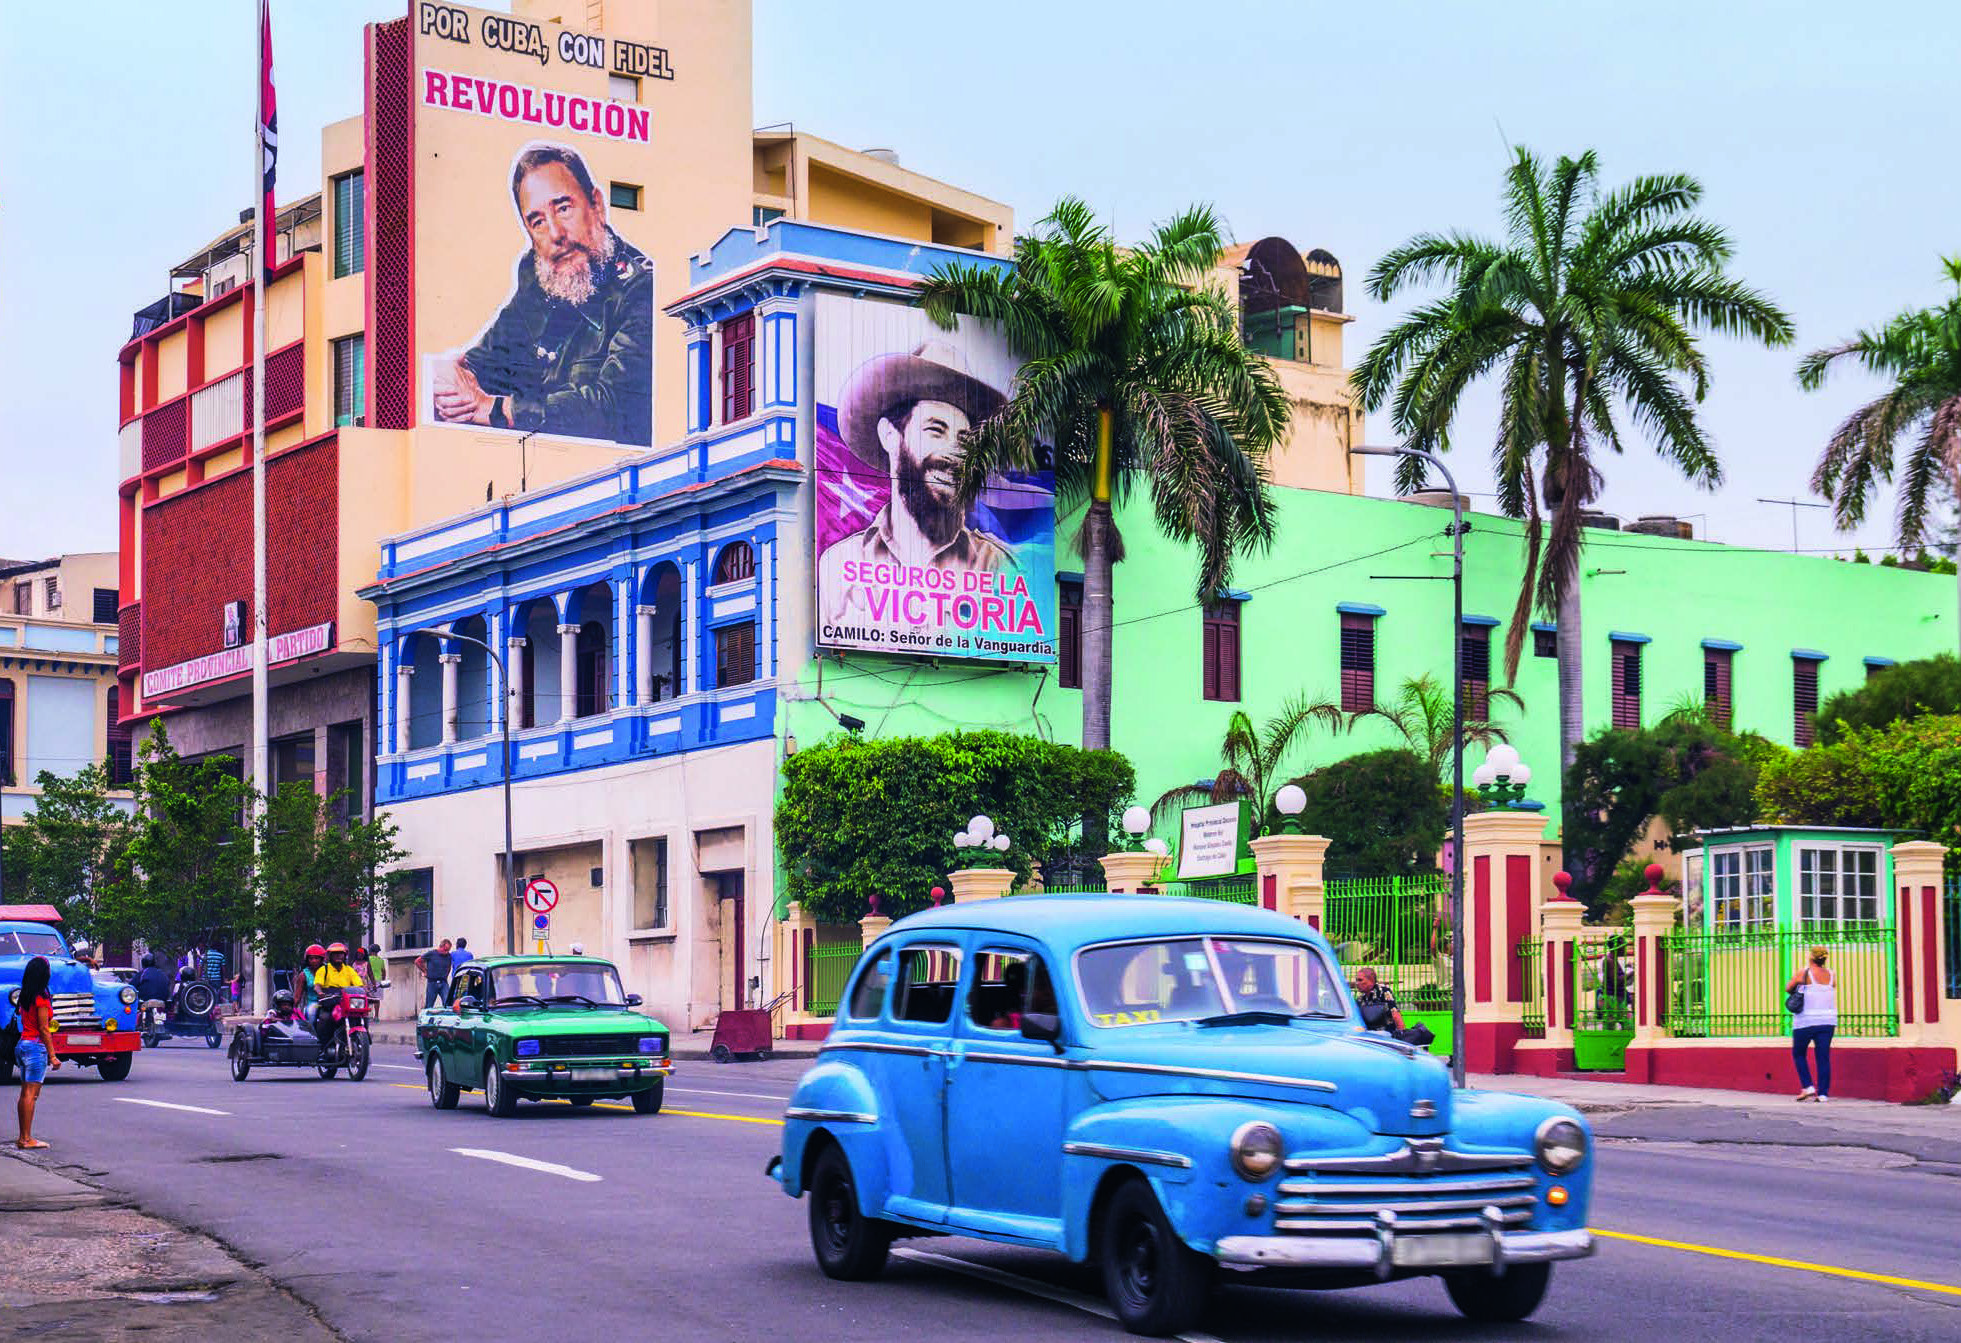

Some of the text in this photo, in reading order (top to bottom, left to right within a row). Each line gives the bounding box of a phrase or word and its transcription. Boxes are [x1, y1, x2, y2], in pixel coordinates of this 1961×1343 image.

[421, 3, 674, 80] POR CUBA, CON FIDEL
[843, 560, 1028, 598] SEGUROS DE LA
[865, 586, 1044, 635] VICTORIA
[187, 648, 248, 684] PROVINCIAL
[276, 626, 324, 660] PARTIDO
[823, 625, 1056, 655] CAMILO: Señor de la Vanguardia.
[1093, 1009, 1158, 1024] TAXI
